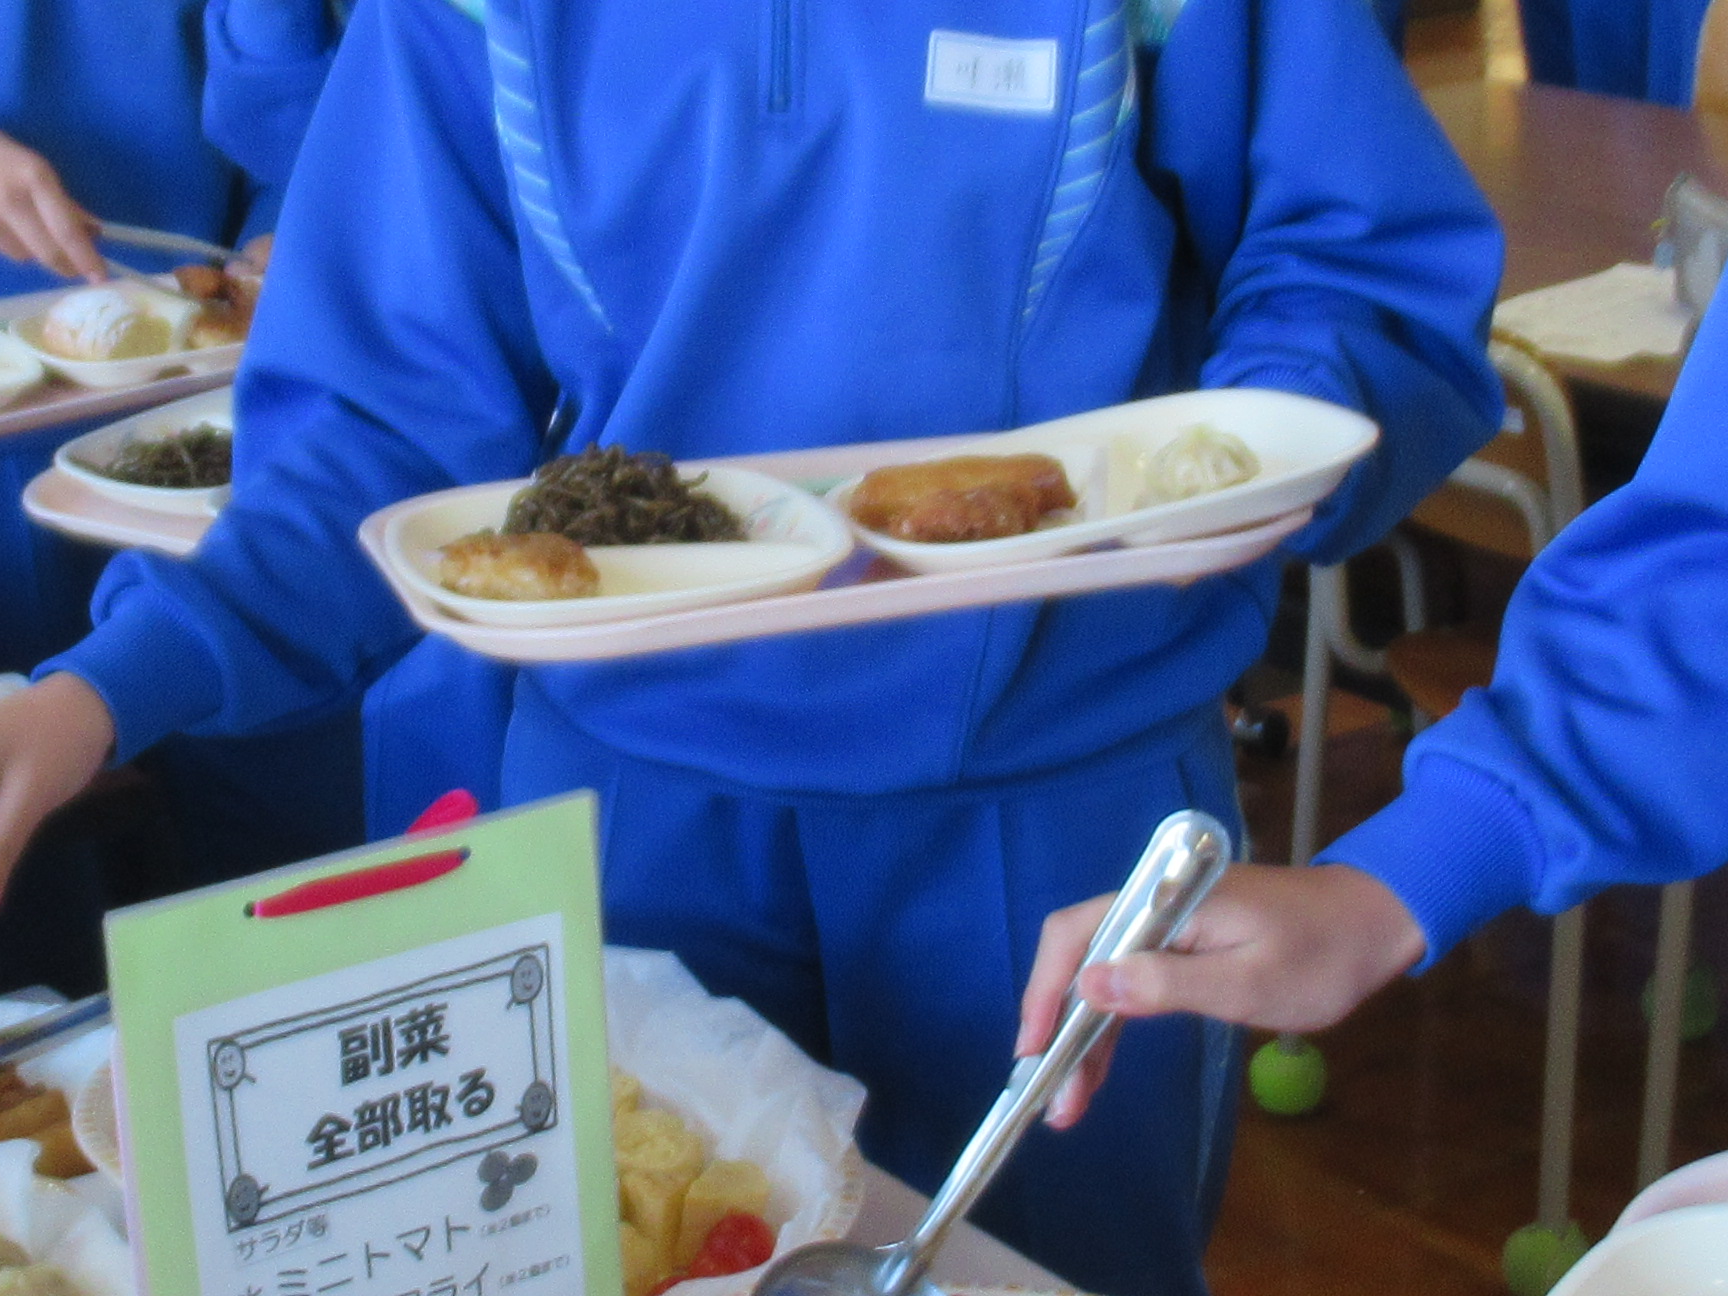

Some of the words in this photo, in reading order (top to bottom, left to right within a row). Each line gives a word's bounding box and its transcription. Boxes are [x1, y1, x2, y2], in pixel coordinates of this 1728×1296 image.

[338, 1003, 451, 1086] 副菜
[305, 1067, 496, 1171] 全部取る
